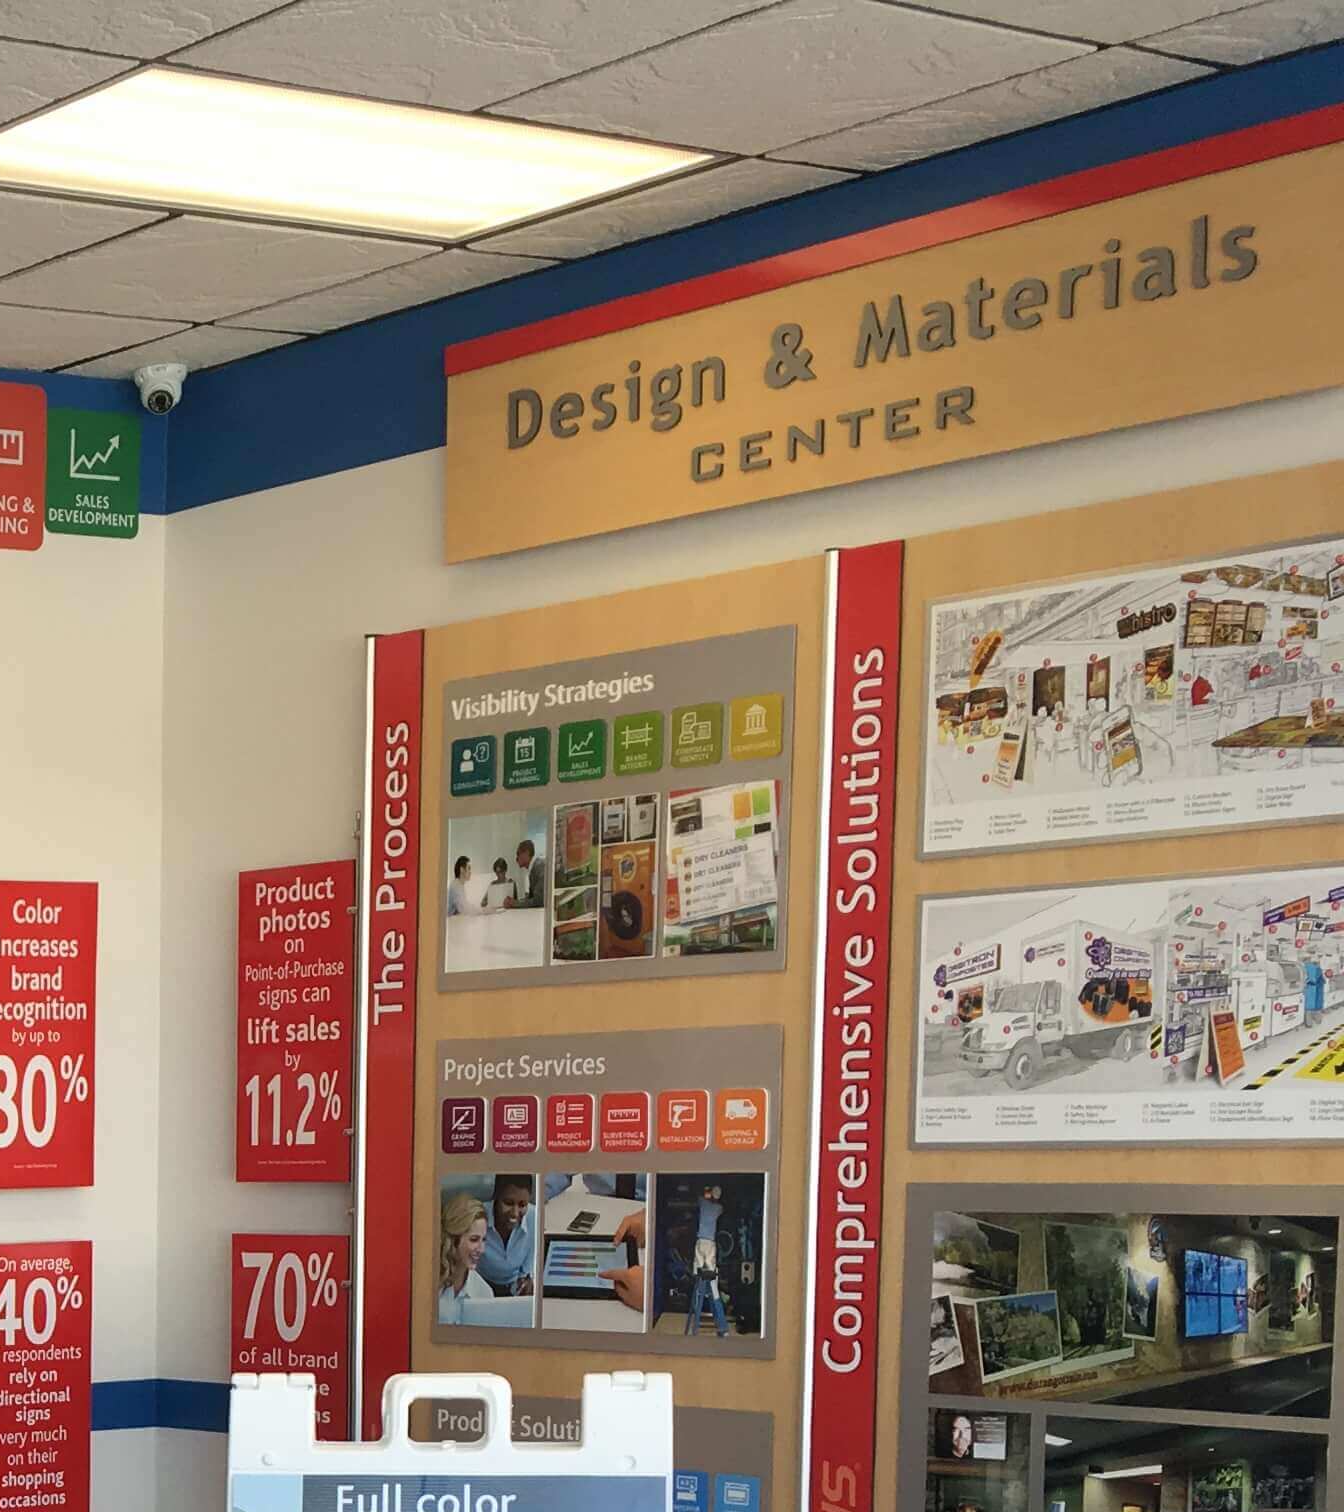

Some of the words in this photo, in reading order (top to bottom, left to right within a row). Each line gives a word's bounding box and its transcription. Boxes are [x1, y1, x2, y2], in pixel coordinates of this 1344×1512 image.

[507, 351, 725, 449] Design
[764, 323, 815, 389] &
[854, 215, 1258, 368] Materials
[691, 386, 977, 482] CENTER
[24, 498, 34, 513] &
[76, 494, 109, 508] SALES
[48, 508, 135, 528] DEVELOPMENT
[451, 689, 540, 721] Visibility
[544, 672, 655, 708] Strategies
[835, 646, 885, 913] Solutions
[376, 720, 409, 912] Process
[255, 877, 335, 906] Product
[12, 899, 62, 924] Color
[259, 909, 331, 941] photos
[284, 937, 304, 954] on
[12, 966, 62, 991] brand
[245, 958, 344, 982] Point-of-Purchase
[373, 929, 404, 1025] The
[259, 988, 297, 1011] signs
[302, 986, 331, 1002] can
[12, 1028, 26, 1046] by
[29, 1030, 44, 1046] up
[48, 1030, 60, 1042] to
[247, 1017, 279, 1045] lift
[286, 1015, 340, 1042] sales
[285, 1050, 301, 1071] by
[444, 1058, 514, 1086] Project
[519, 1054, 606, 1079] Services
[245, 1070, 341, 1146] 11.2%
[822, 933, 876, 1374] Comprehensive
[20, 1256, 73, 1276] average,
[241, 1252, 337, 1342] 70%
[3, 1346, 81, 1365] respondents
[239, 1347, 257, 1364] of
[262, 1348, 282, 1366] all
[288, 1349, 338, 1369] brand
[9, 1370, 36, 1385] rely
[40, 1370, 57, 1382] on
[16, 1407, 50, 1426] signs
[520, 1416, 581, 1441] Soluti
[0, 1432, 26, 1449] very
[31, 1427, 67, 1443] much
[7, 1453, 23, 1465] on
[28, 1449, 58, 1464] their
[1, 1470, 64, 1490] shopping
[0, 1490, 66, 1509] occasions
